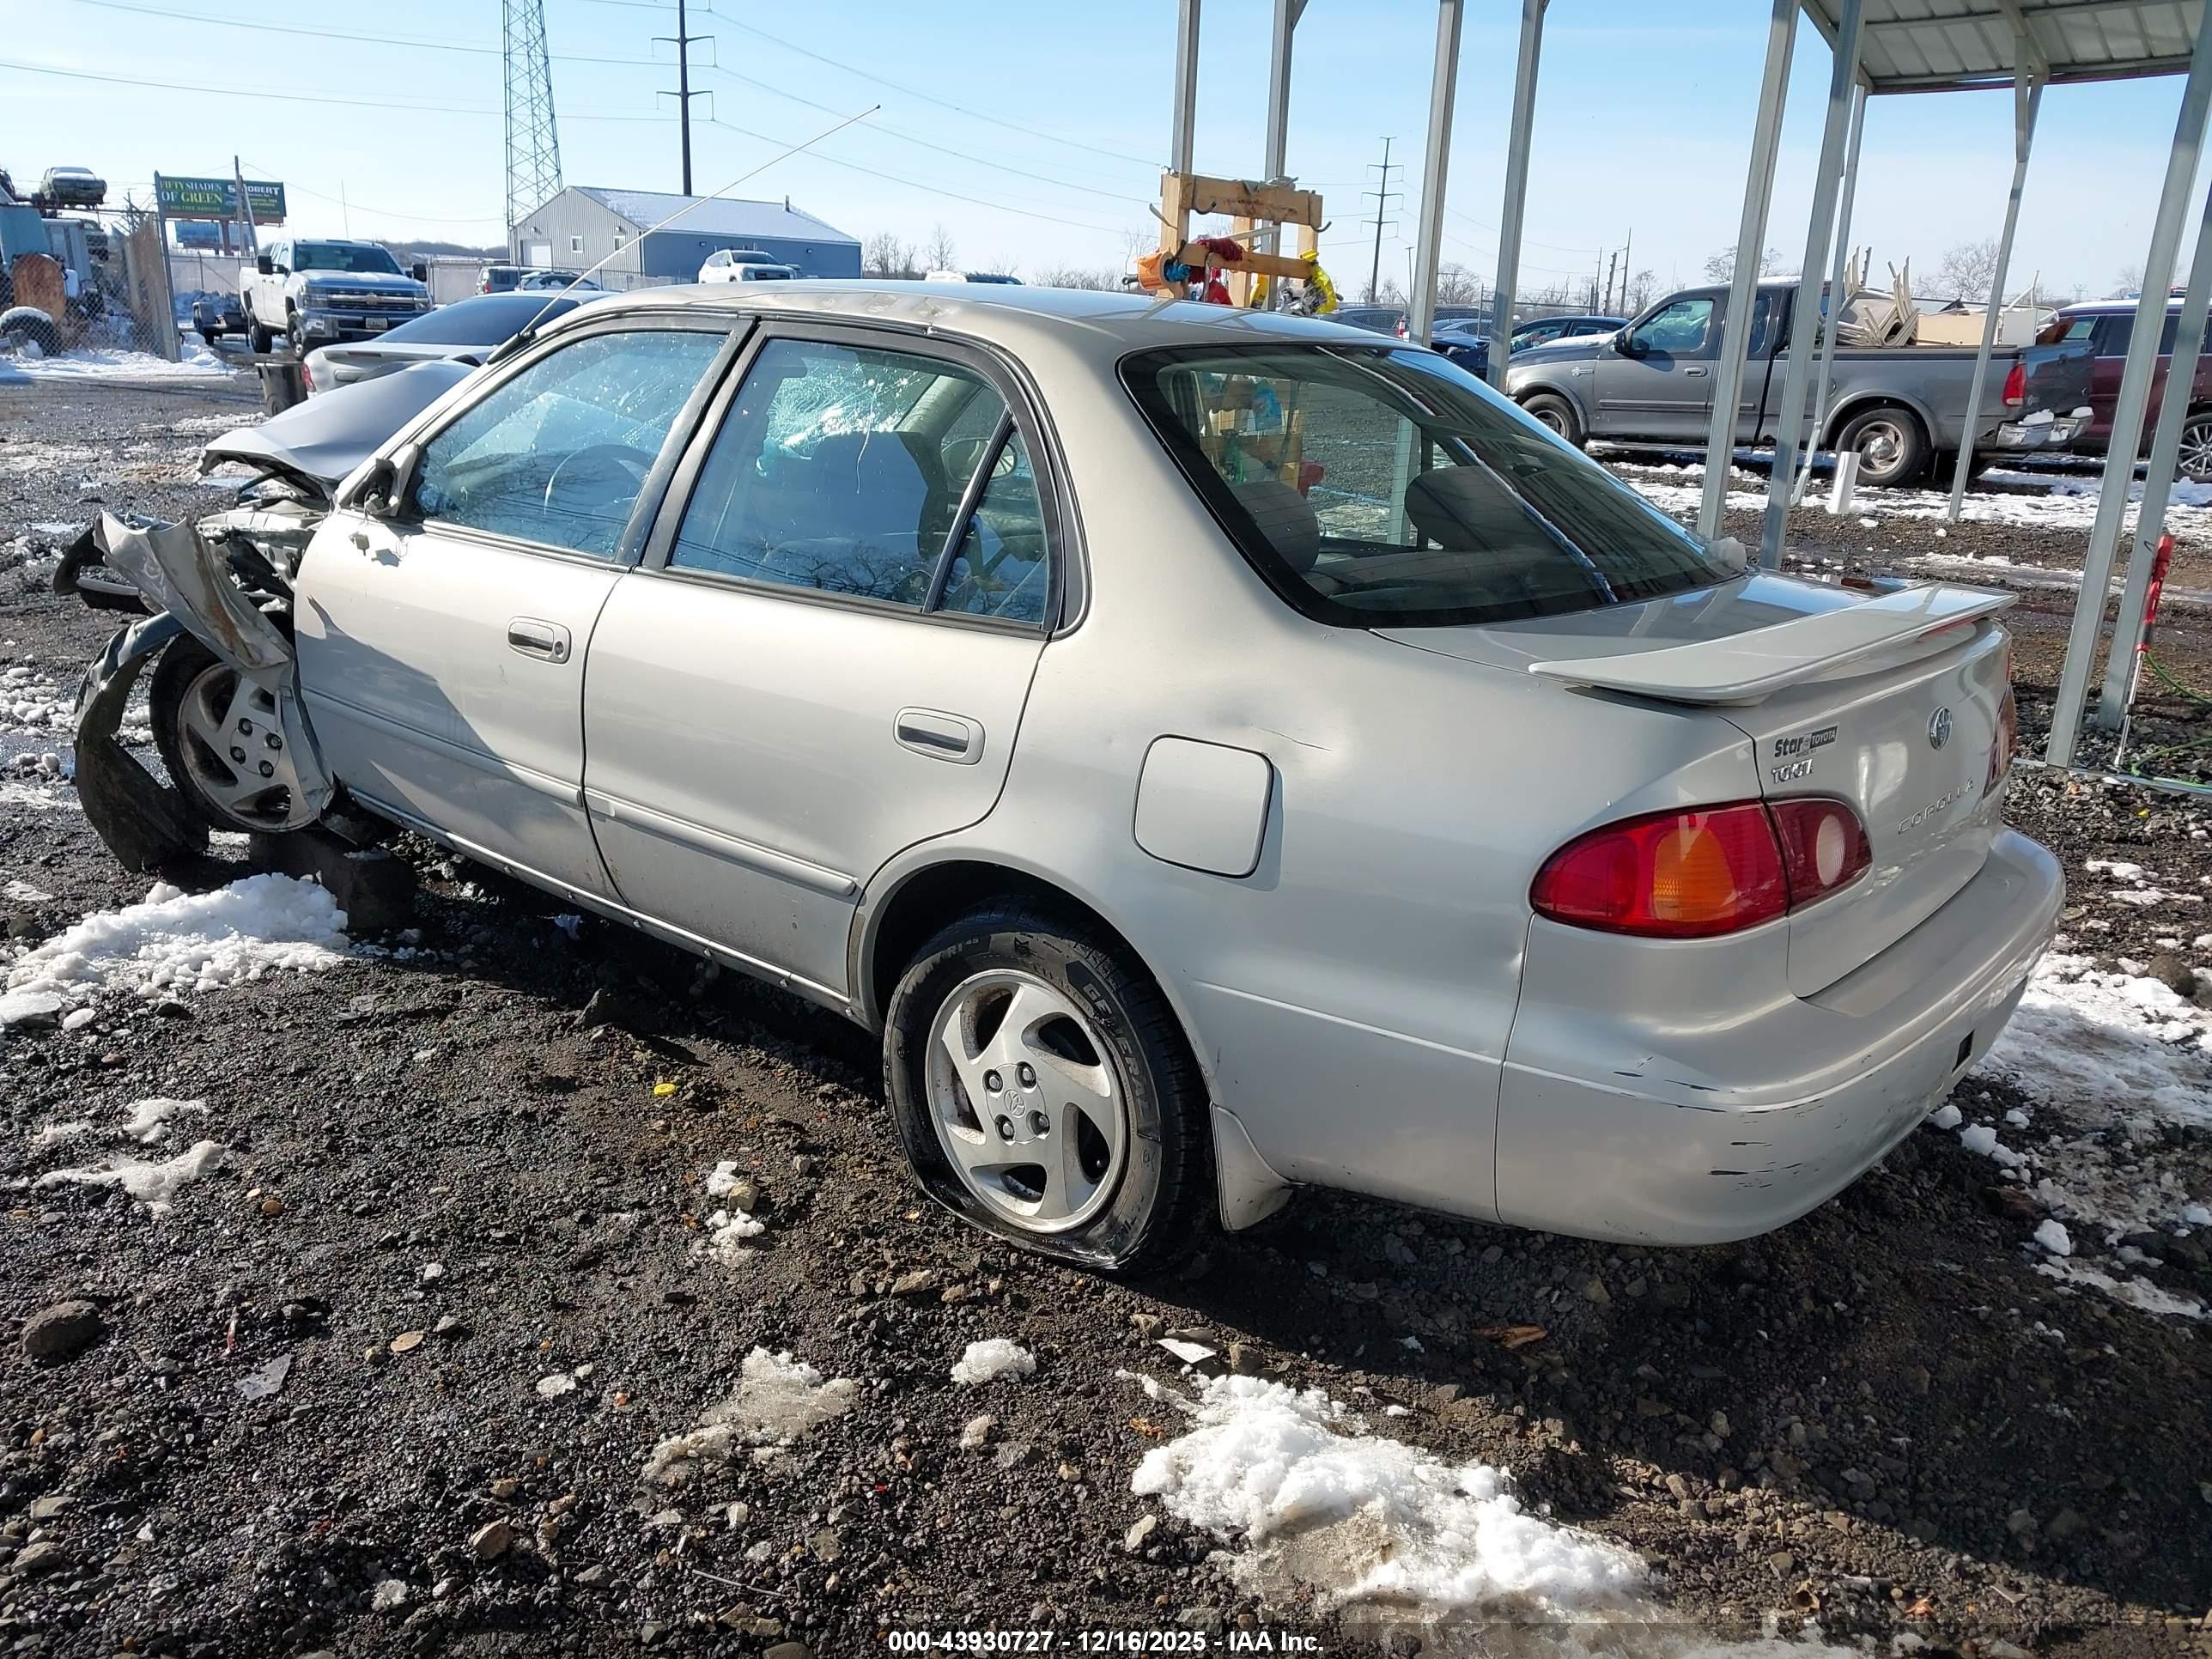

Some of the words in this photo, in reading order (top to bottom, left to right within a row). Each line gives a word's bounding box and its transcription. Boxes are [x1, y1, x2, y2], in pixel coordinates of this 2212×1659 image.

[185, 182, 222, 191] SHADES
[161, 191, 178, 202] OF
[181, 192, 222, 204] GREEN
[1774, 736, 1804, 757] Star
[1811, 729, 1836, 744] TOYOTA
[1898, 777, 1973, 834] COROLLA
